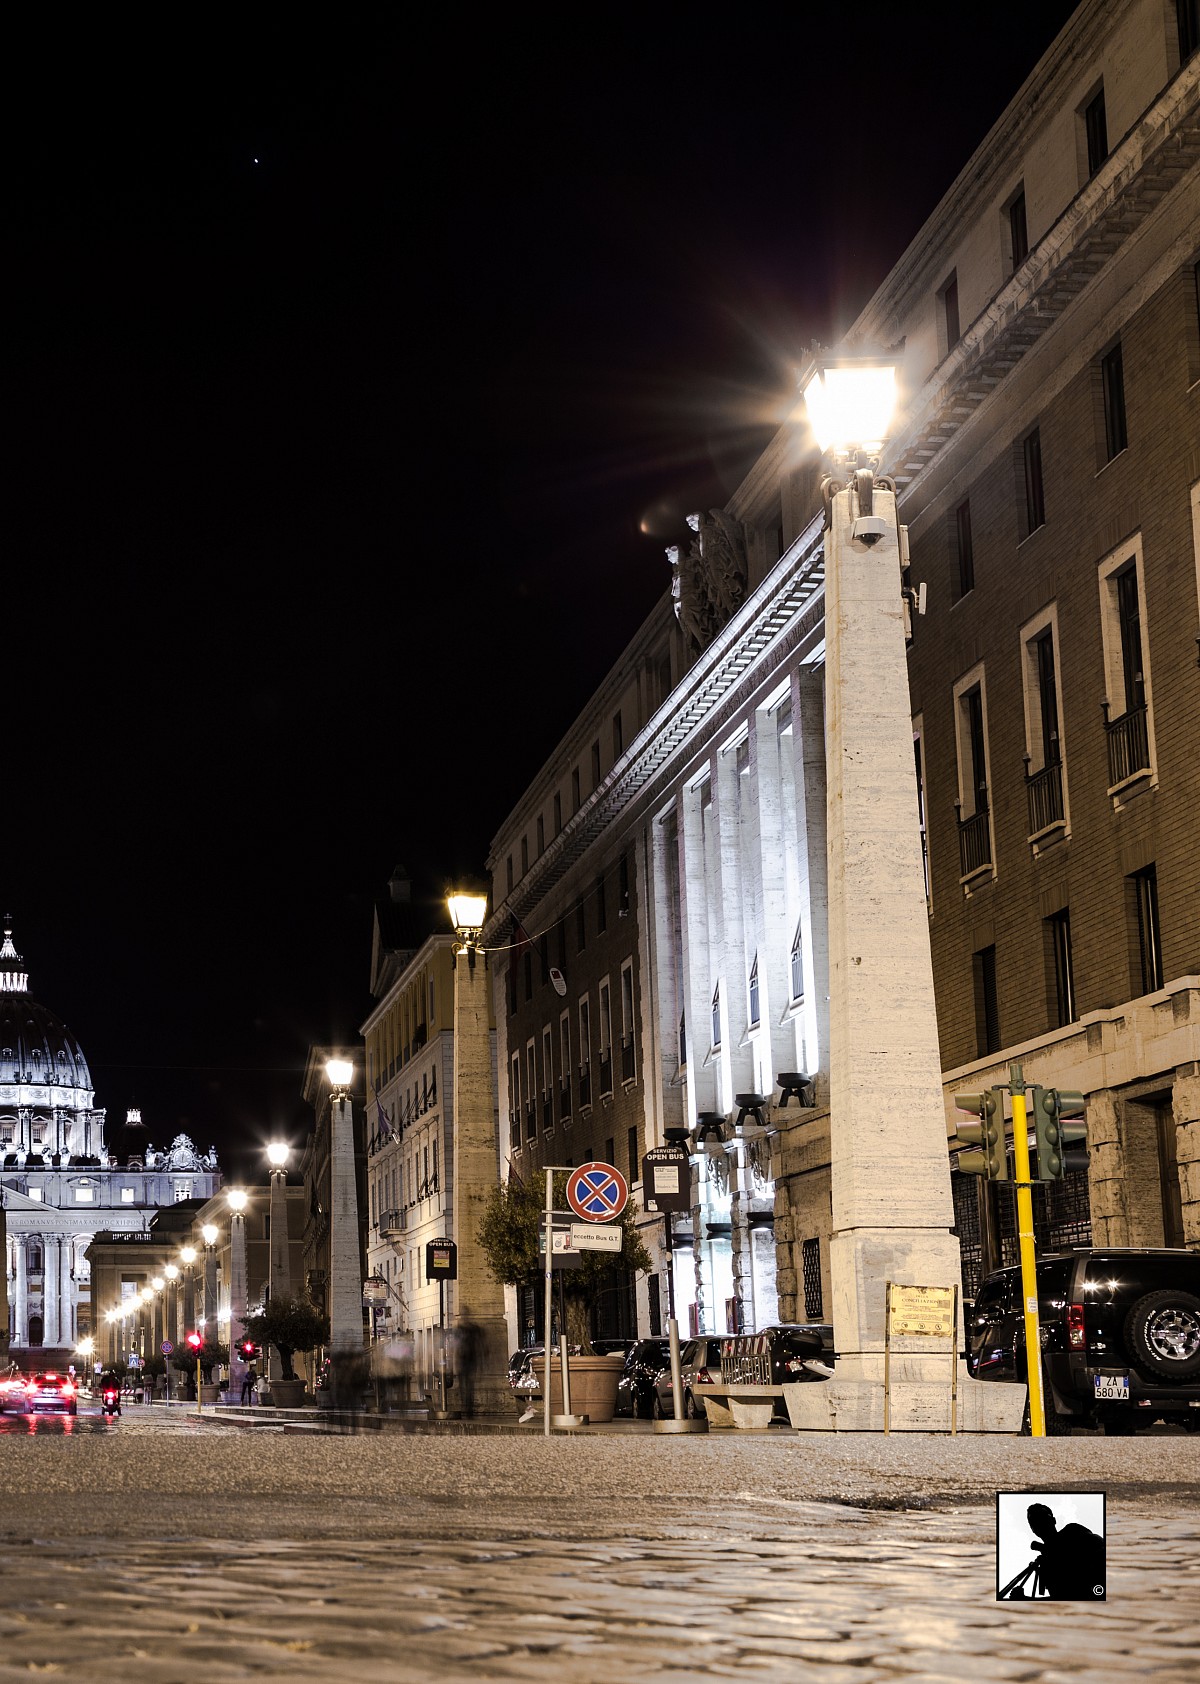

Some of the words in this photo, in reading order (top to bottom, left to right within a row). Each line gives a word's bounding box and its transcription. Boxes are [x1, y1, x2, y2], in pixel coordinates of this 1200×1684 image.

[1106, 1376, 1118, 1387] ZA
[1096, 1387, 1114, 1398] 580
[1117, 1388, 1128, 1398] VA
